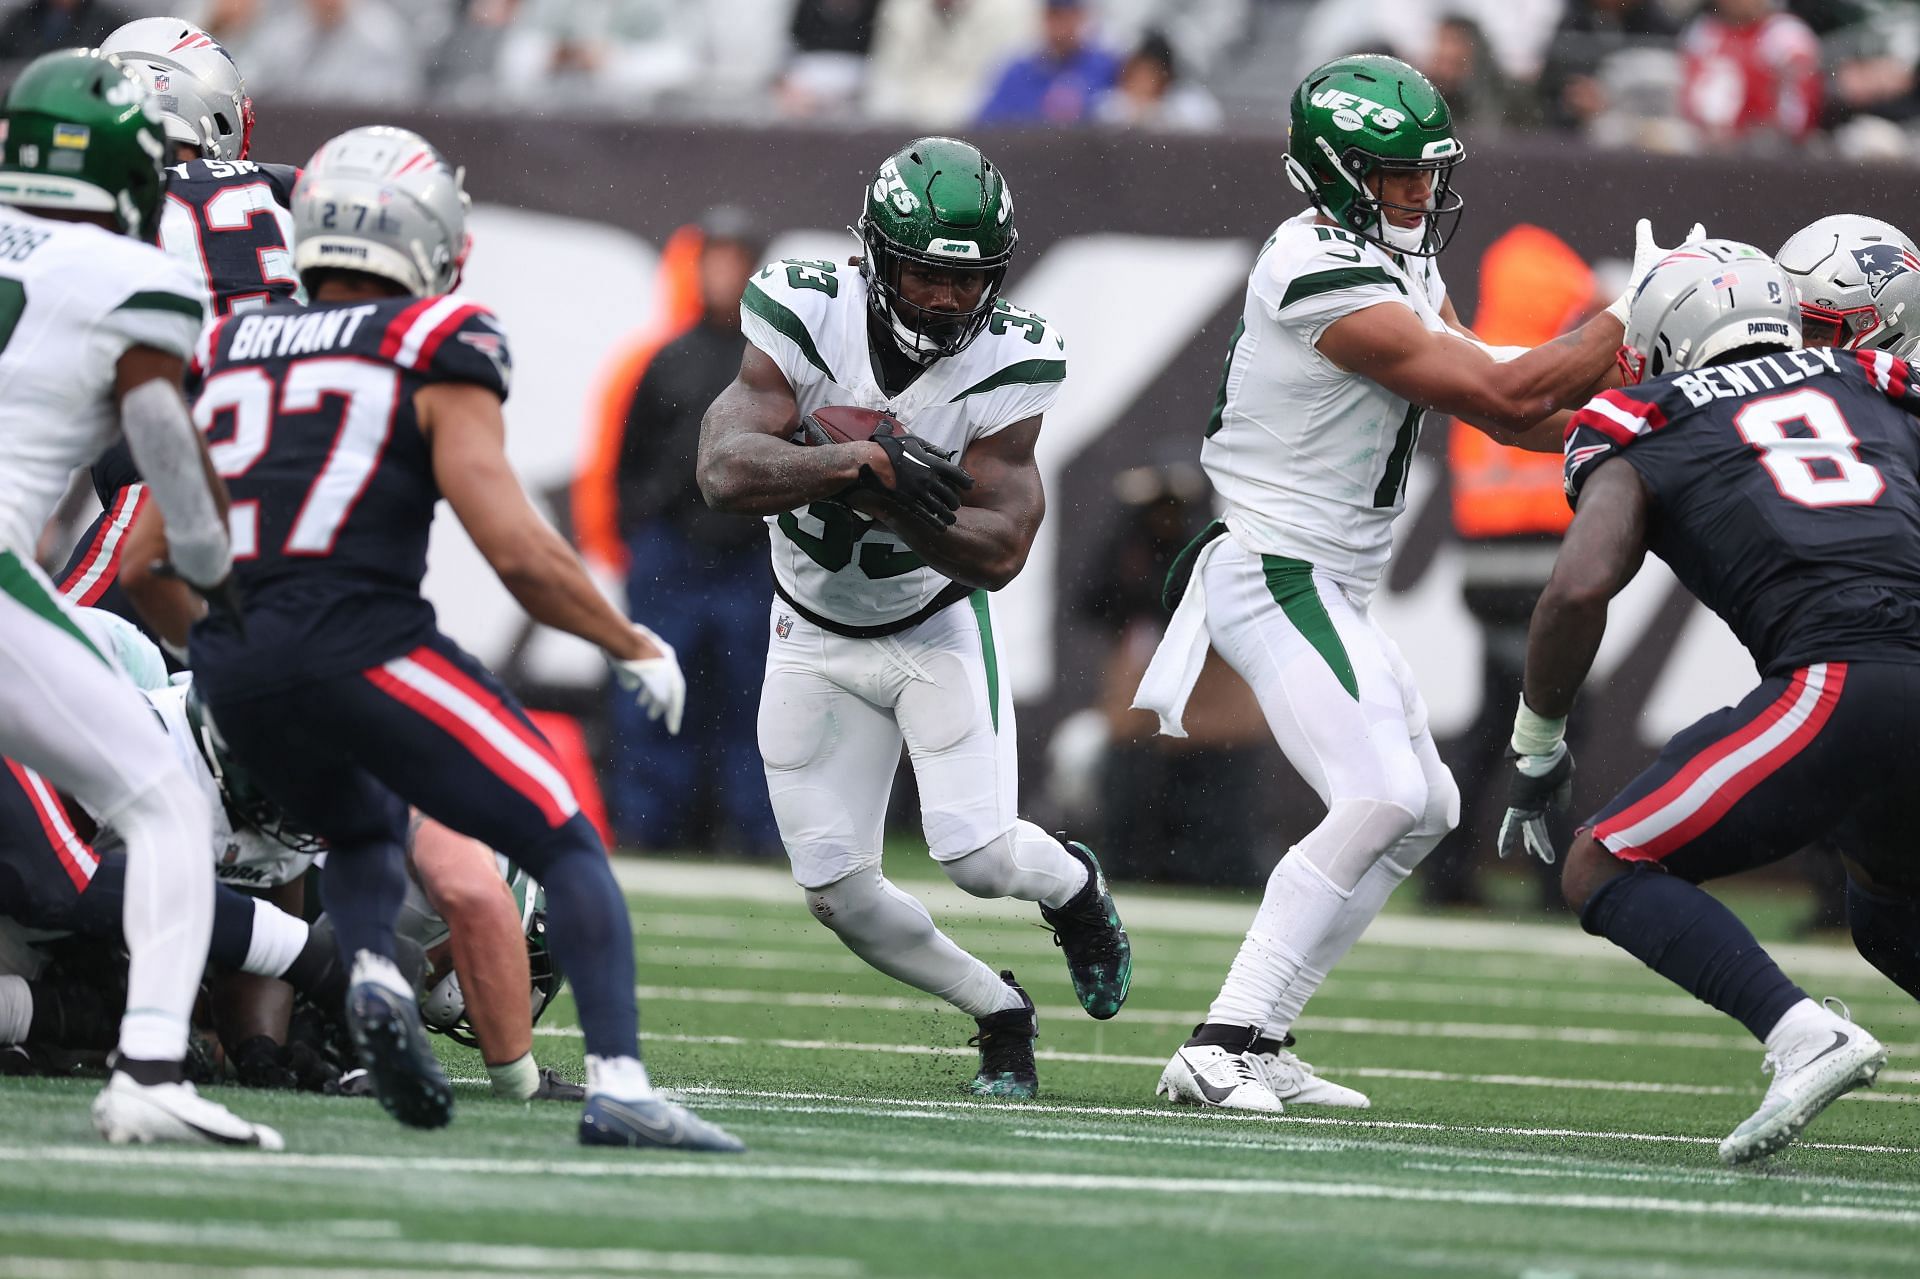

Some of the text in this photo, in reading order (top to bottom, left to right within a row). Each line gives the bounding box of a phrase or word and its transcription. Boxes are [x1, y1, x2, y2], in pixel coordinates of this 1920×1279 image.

[1311, 88, 1406, 130] JETS
[322, 203, 367, 231] 27
[943, 243, 971, 253] JETS
[1767, 281, 1782, 304] 8
[228, 304, 378, 361] BRYANT
[1748, 322, 1789, 337] PATRIOTS
[1671, 346, 1842, 408] BENTLEY
[192, 355, 401, 561] 27
[1732, 386, 1888, 510] 8
